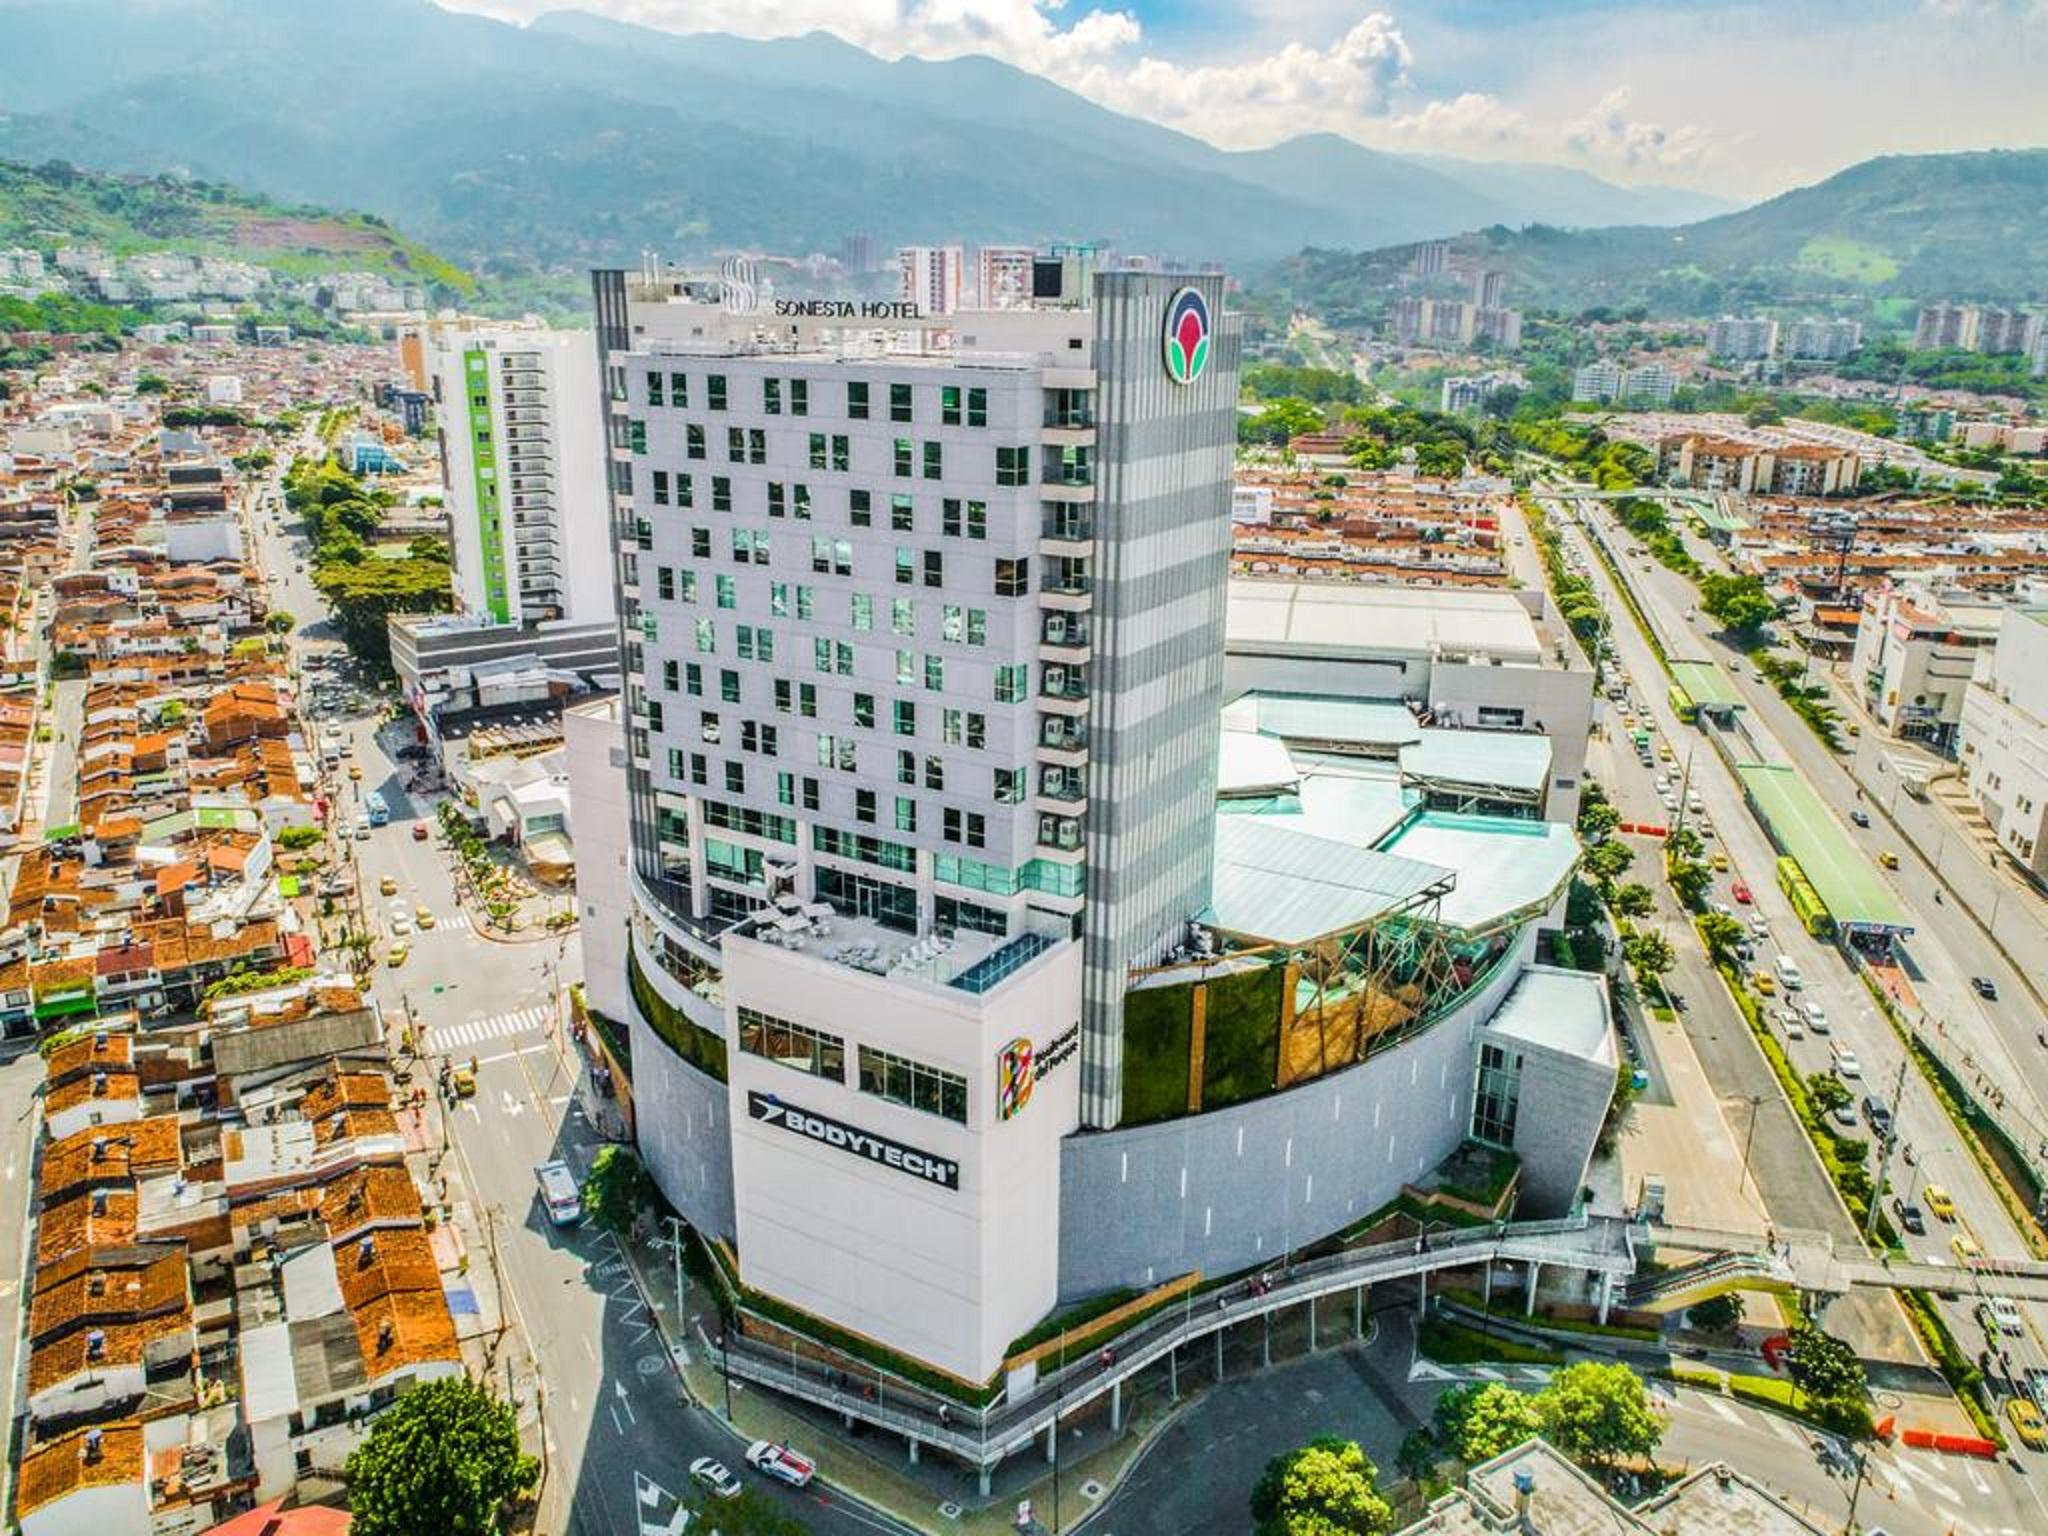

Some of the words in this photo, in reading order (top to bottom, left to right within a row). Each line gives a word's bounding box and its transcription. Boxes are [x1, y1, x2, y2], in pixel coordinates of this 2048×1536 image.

[775, 299, 856, 318] SONESTA
[862, 301, 925, 320] HOTEL
[785, 1110, 947, 1183] BODYTECH
